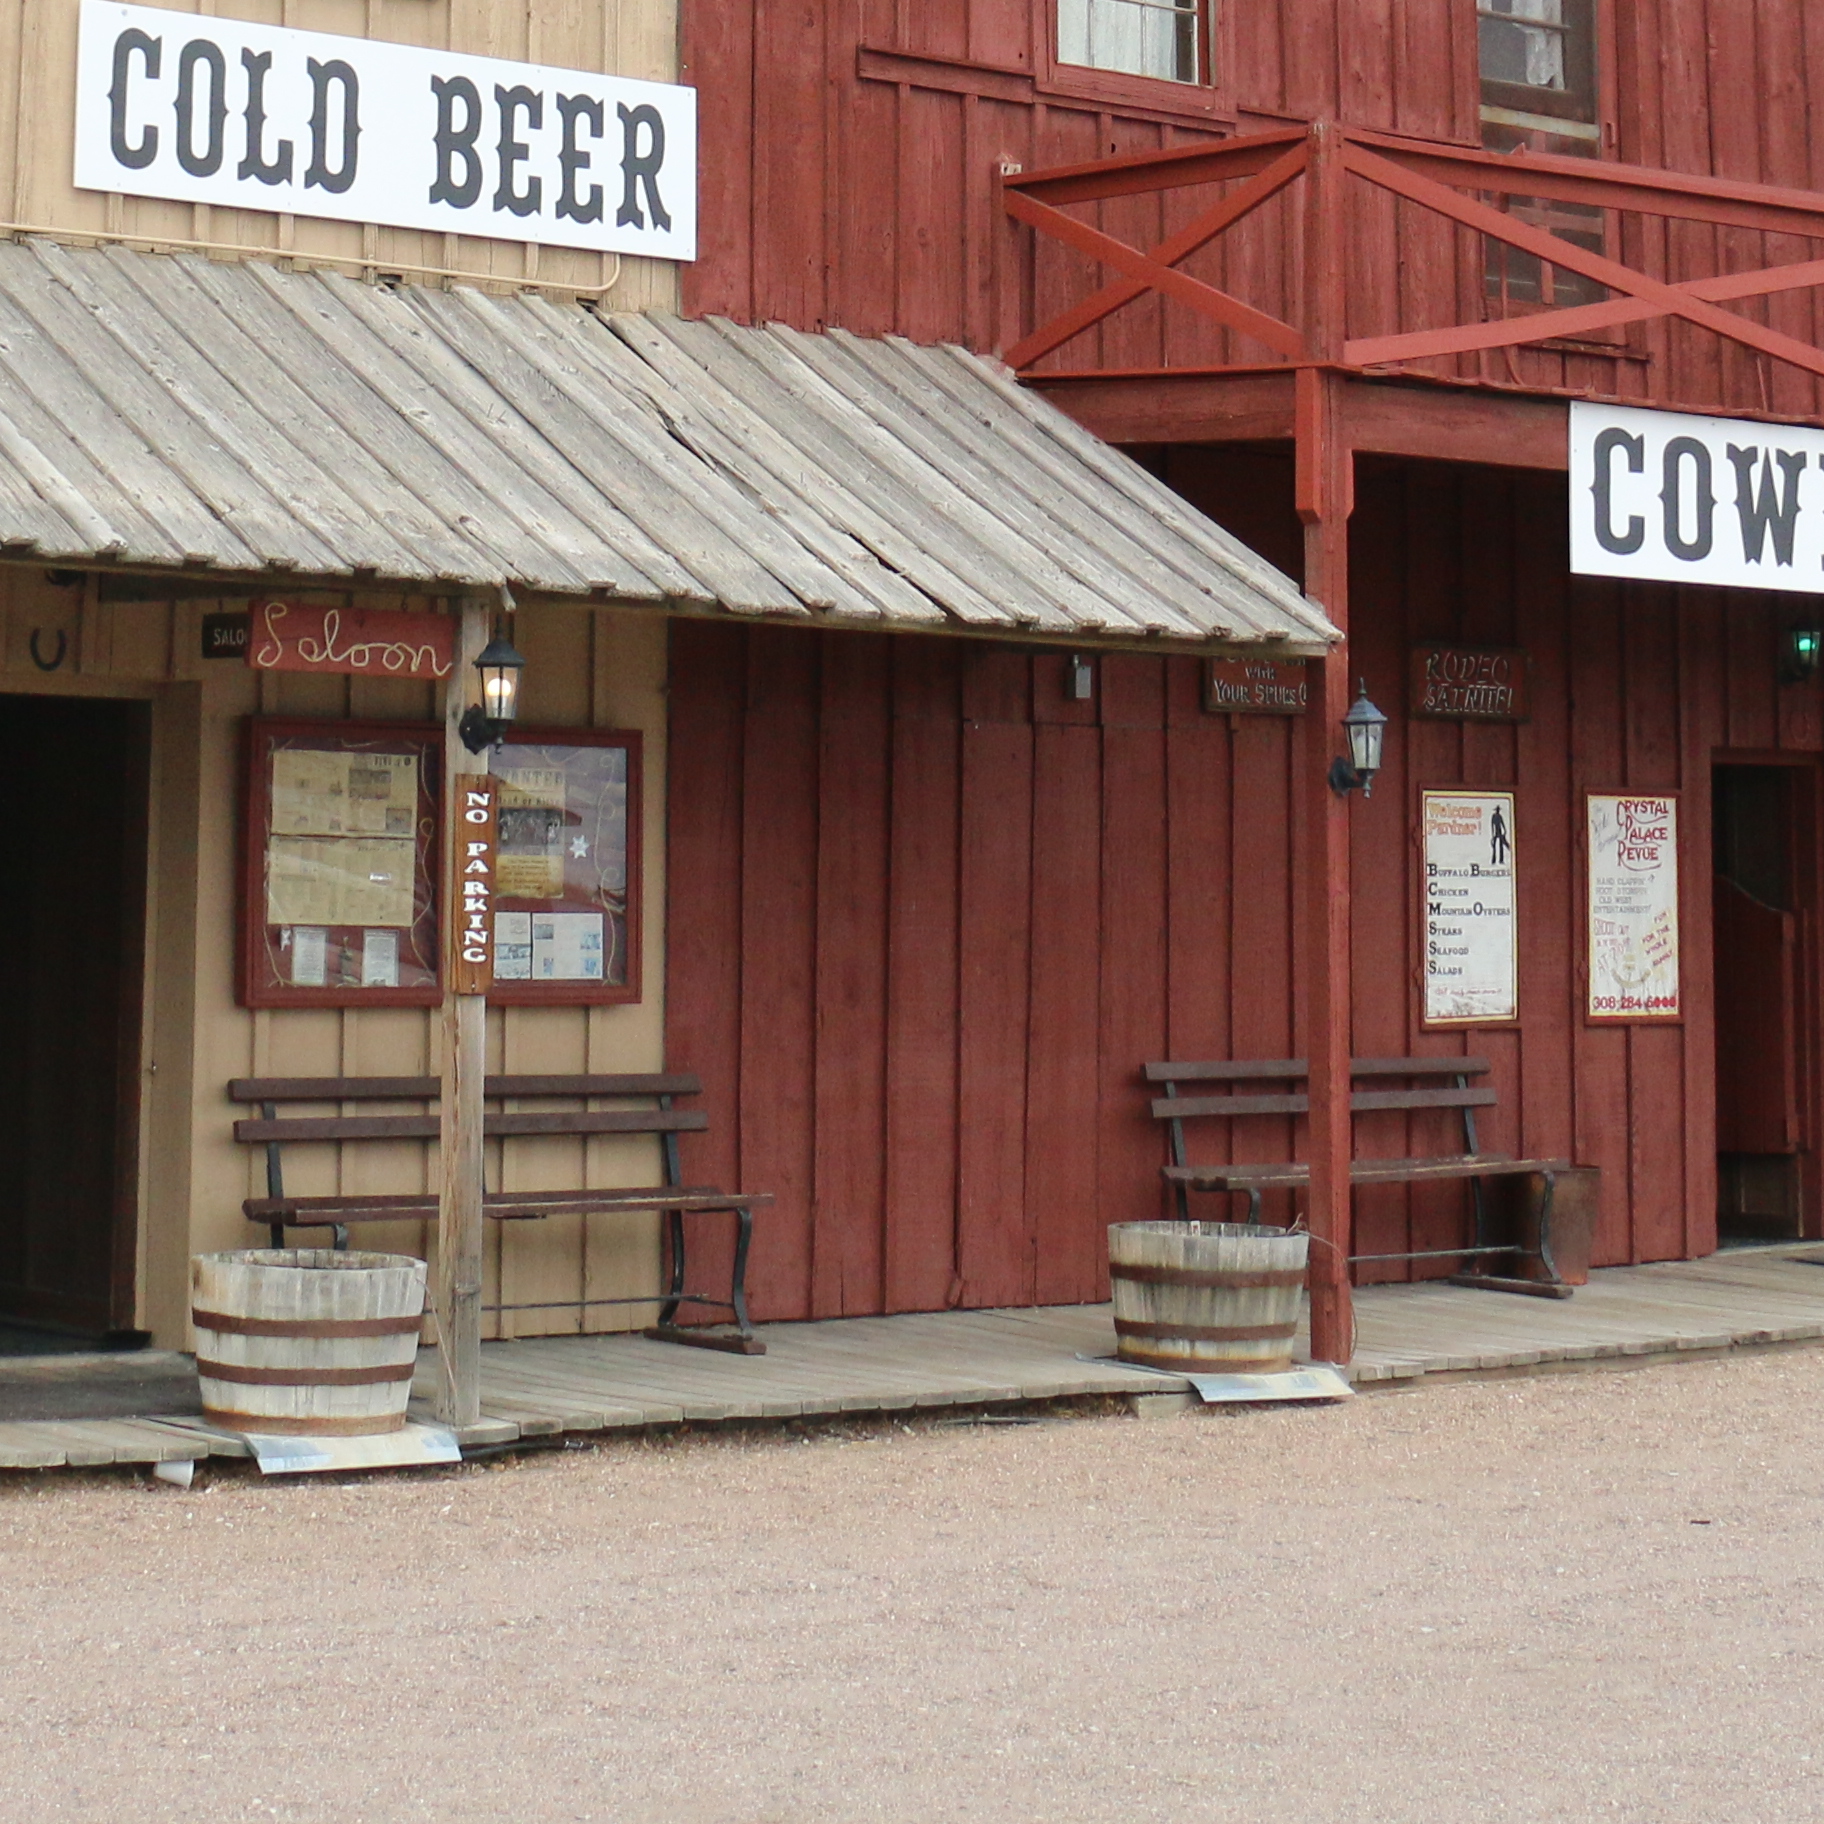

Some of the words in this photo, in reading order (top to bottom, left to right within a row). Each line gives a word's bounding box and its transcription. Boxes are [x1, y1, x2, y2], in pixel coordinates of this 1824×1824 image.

[107, 26, 363, 194] COLD
[429, 73, 672, 233] BEER
[212, 628, 248, 646] SALO
[256, 601, 454, 676] Saloon
[1425, 651, 1510, 686] RODEO
[1213, 679, 1251, 704] YOUR
[464, 792, 491, 824] NO
[1616, 799, 1669, 826] CRYSTAL
[1624, 814, 1668, 842] PALACE
[1616, 839, 1660, 867] REVUE
[462, 842, 490, 963] PARKING
